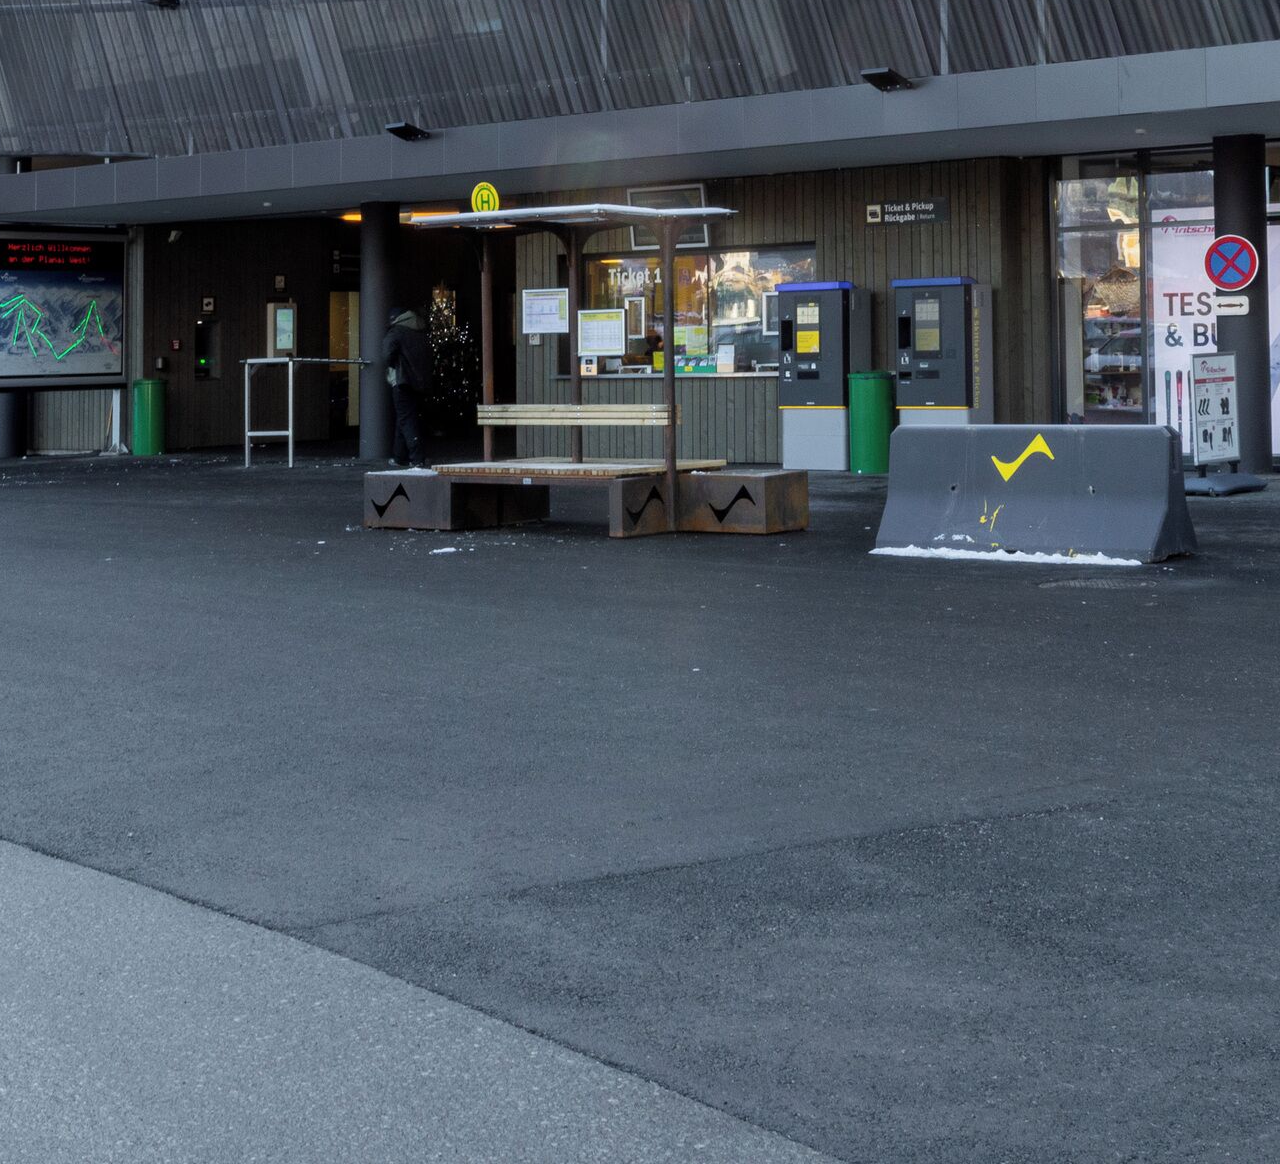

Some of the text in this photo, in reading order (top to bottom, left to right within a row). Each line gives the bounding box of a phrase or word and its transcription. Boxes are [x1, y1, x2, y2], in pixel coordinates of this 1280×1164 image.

[480, 193, 491, 212] H
[884, 203, 904, 213] Ticket
[911, 201, 934, 212] Pickup
[884, 213, 916, 224] Rückgabe
[7, 243, 92, 253] Herzlich Willkommen
[21, 255, 36, 263] der
[38, 254, 65, 264] Planai
[608, 267, 651, 286] Ticket
[654, 268, 662, 284] 1
[1162, 291, 1218, 317] TES
[1165, 322, 1184, 348] &
